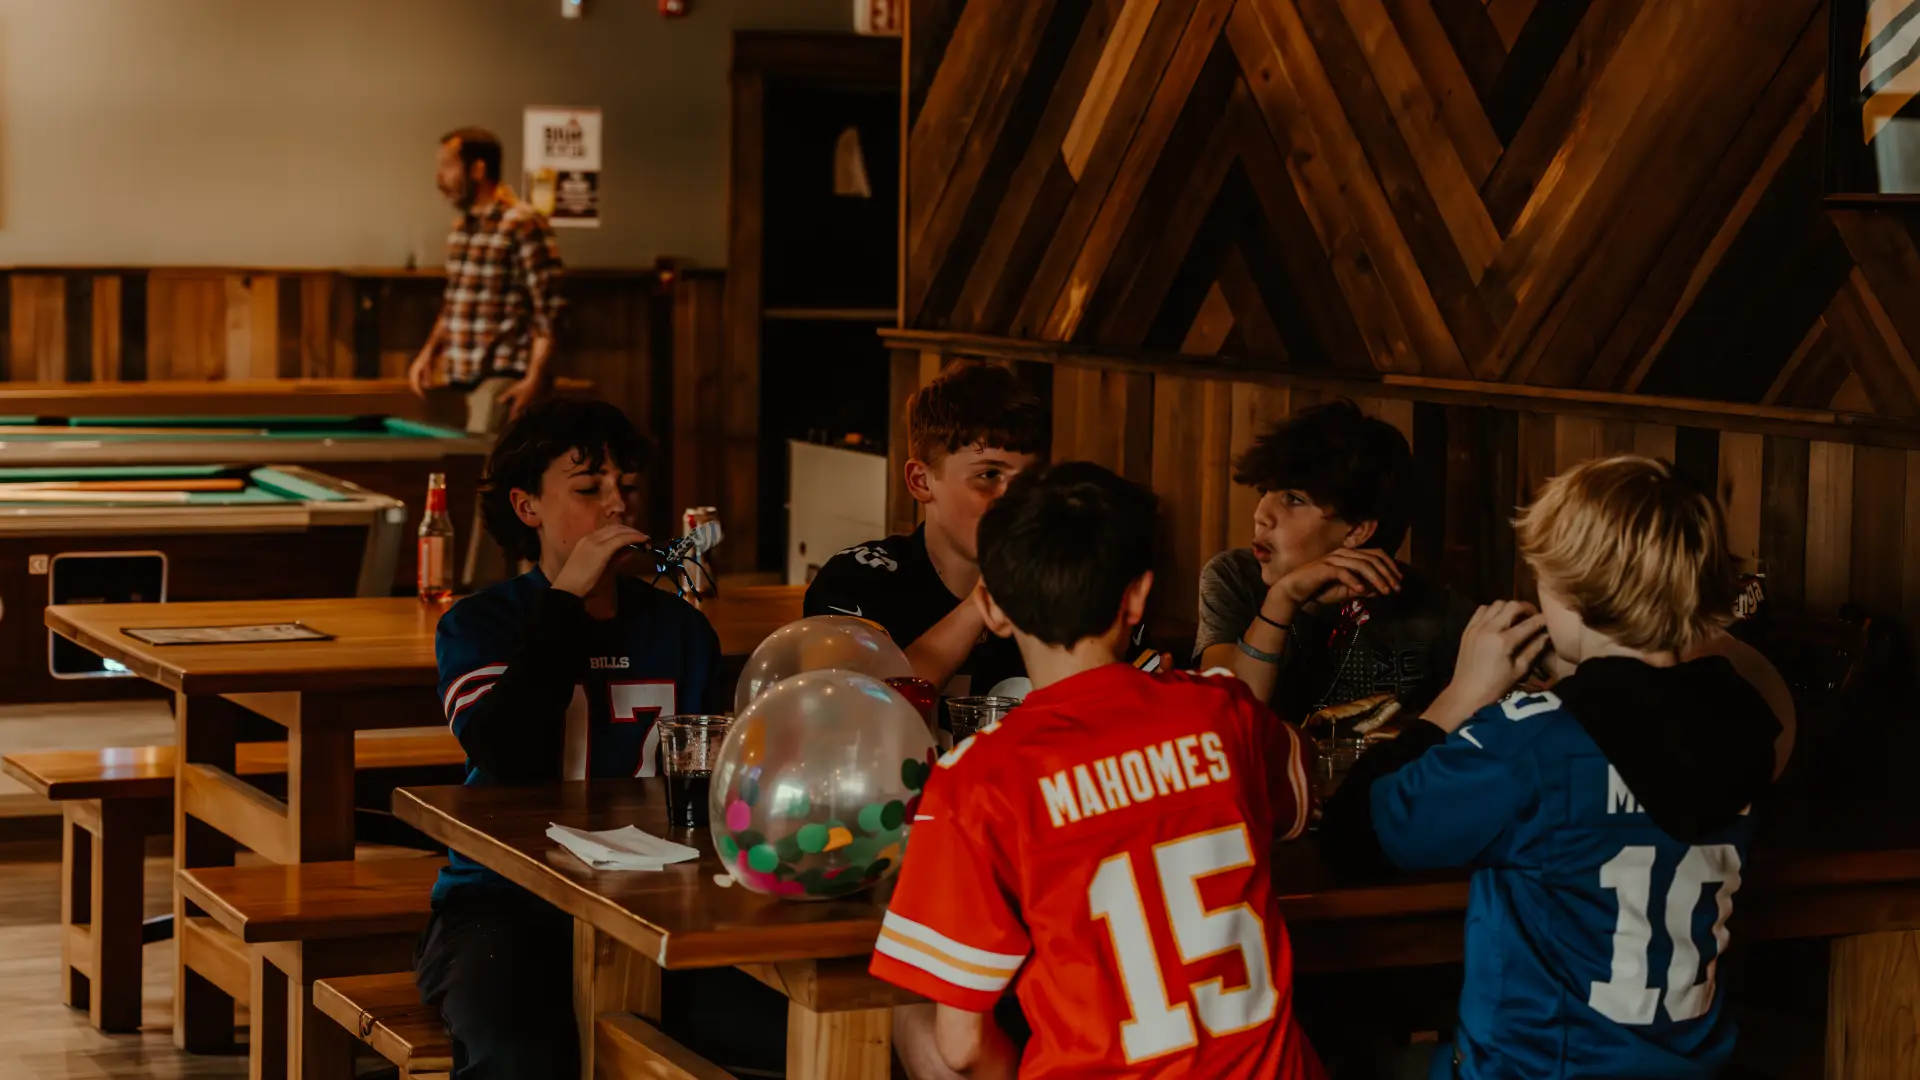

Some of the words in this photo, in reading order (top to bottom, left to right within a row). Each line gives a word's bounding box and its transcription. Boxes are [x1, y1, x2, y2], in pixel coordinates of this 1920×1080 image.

[589, 656, 630, 669] BILLS
[1037, 731, 1231, 829] MAHOMES
[1087, 823, 1279, 1064] 15
[1589, 843, 1741, 1025] 10
